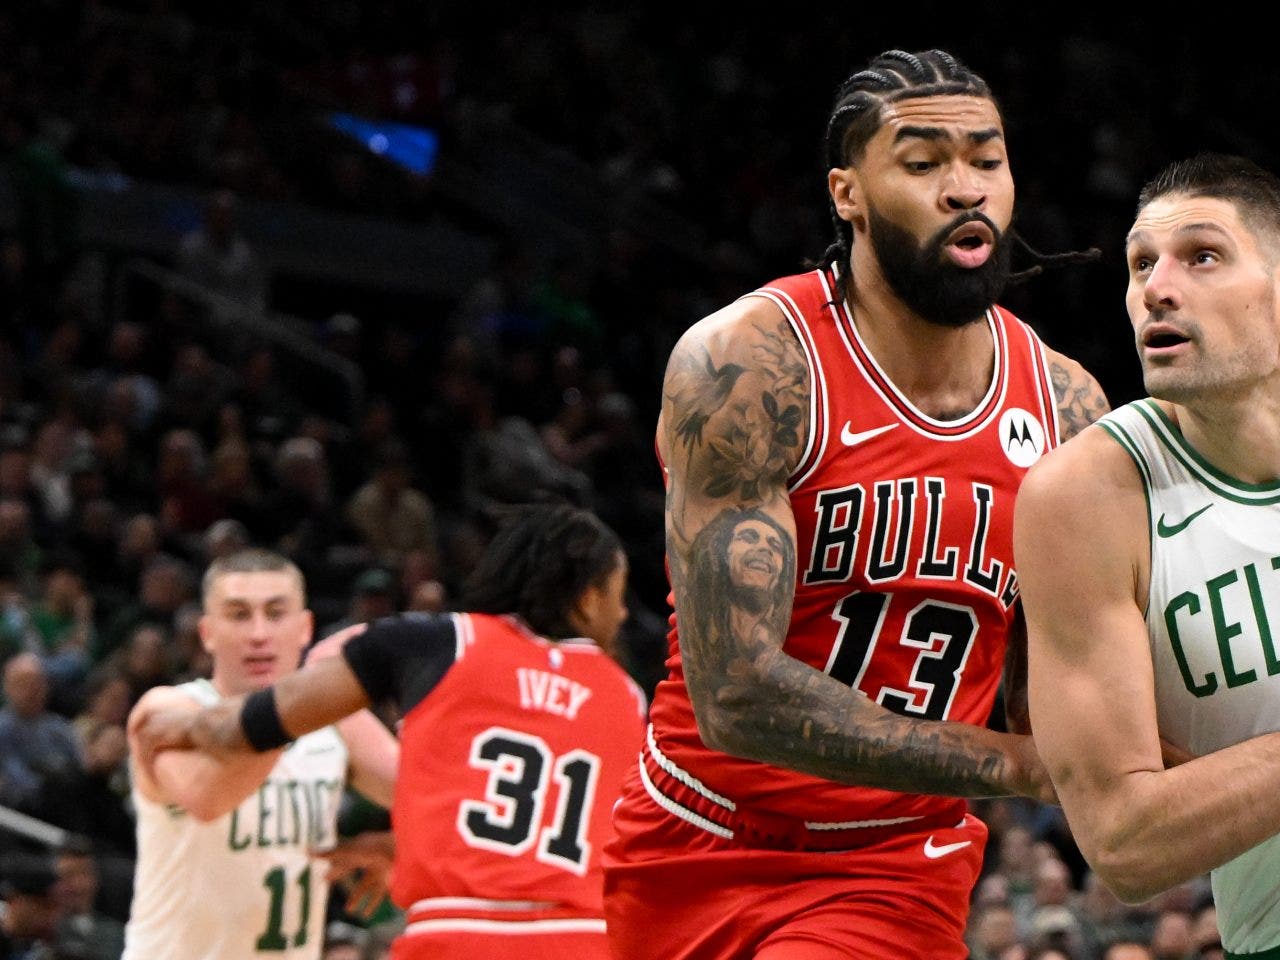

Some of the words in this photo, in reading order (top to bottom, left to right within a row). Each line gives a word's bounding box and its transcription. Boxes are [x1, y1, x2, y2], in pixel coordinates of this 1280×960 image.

[516, 667, 593, 720] IVEY
[831, 589, 980, 722] 13
[456, 725, 601, 878] 31
[256, 865, 311, 953] 11
